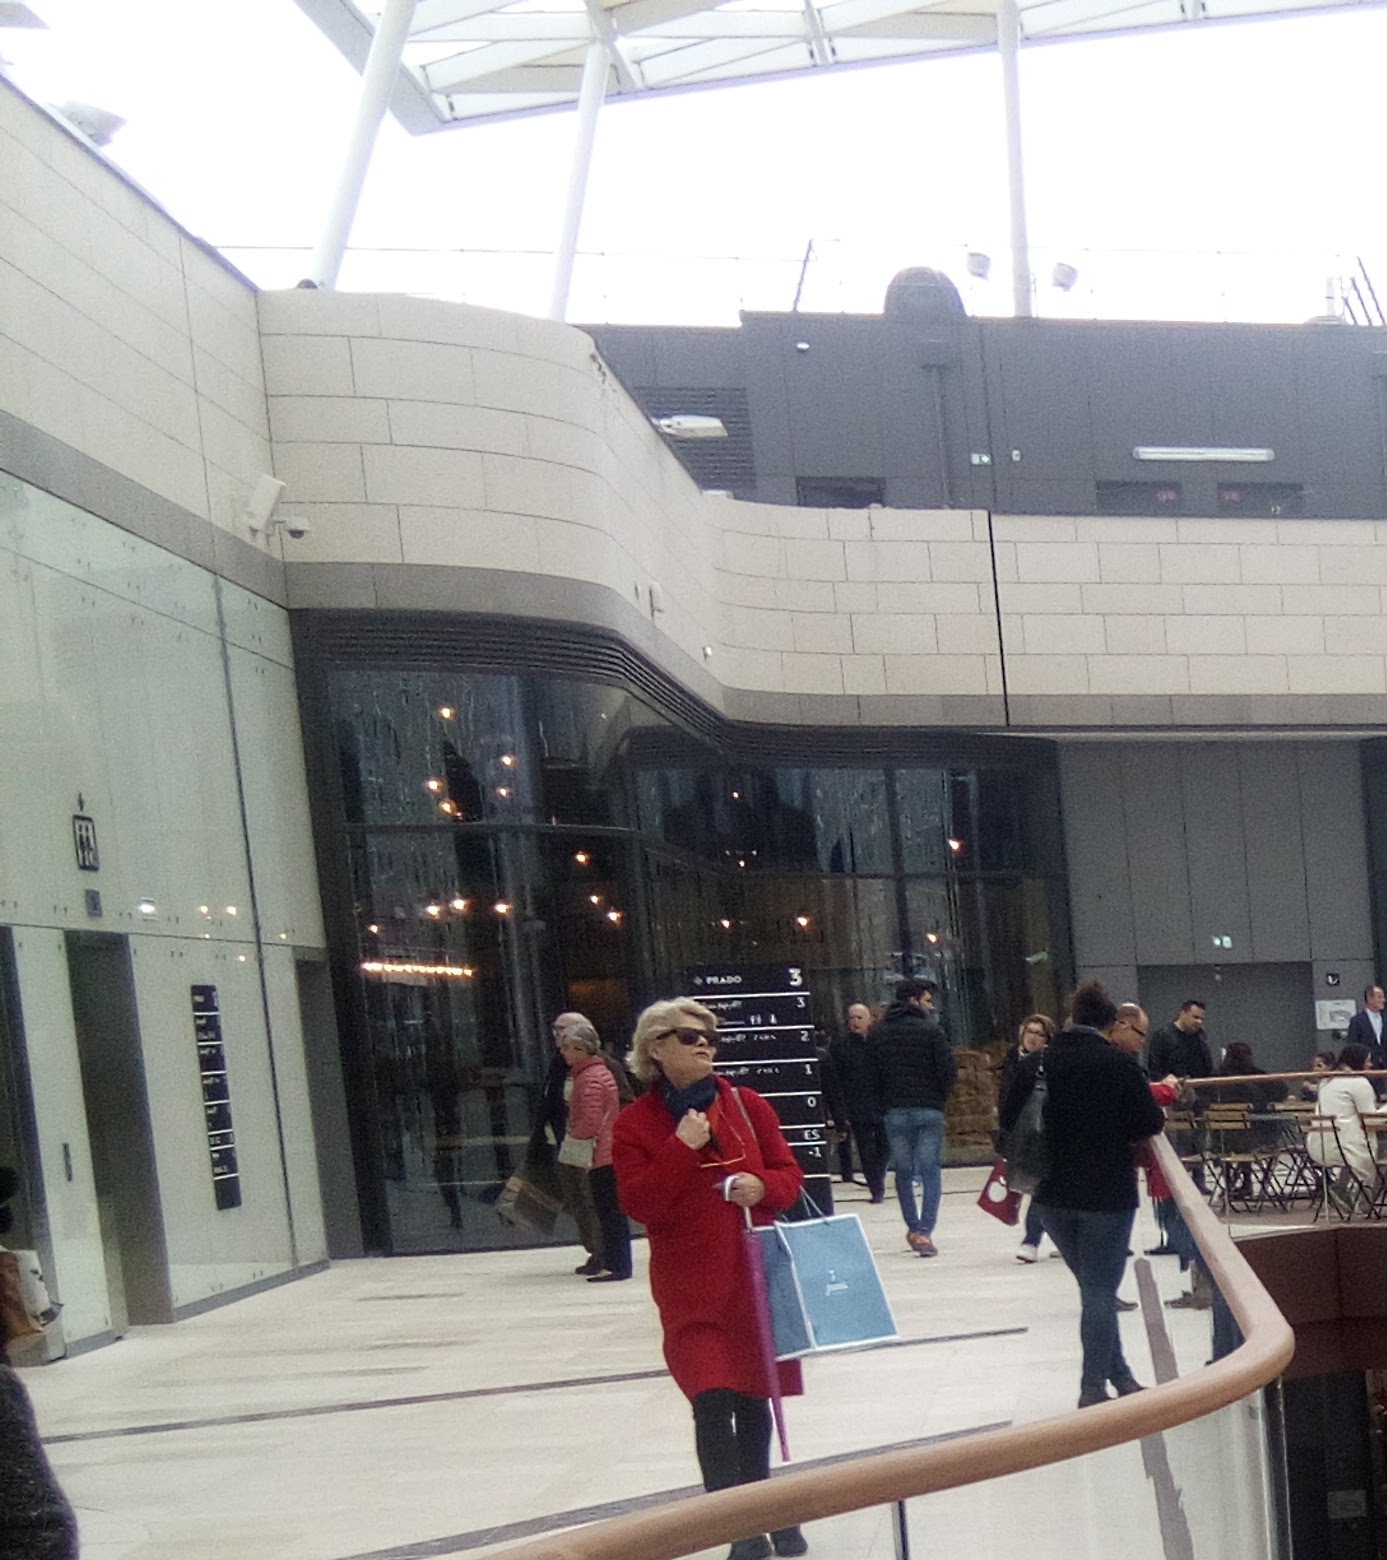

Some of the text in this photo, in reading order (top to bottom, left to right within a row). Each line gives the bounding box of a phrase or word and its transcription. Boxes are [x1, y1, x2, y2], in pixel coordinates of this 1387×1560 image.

[706, 968, 803, 986] PRADO 3
[796, 997, 806, 1008] 3
[801, 1030, 809, 1042] 2
[805, 1064, 812, 1075] 1
[807, 1097, 817, 1108] 0
[804, 1129, 821, 1140] ES
[808, 1147, 822, 1158] -1
